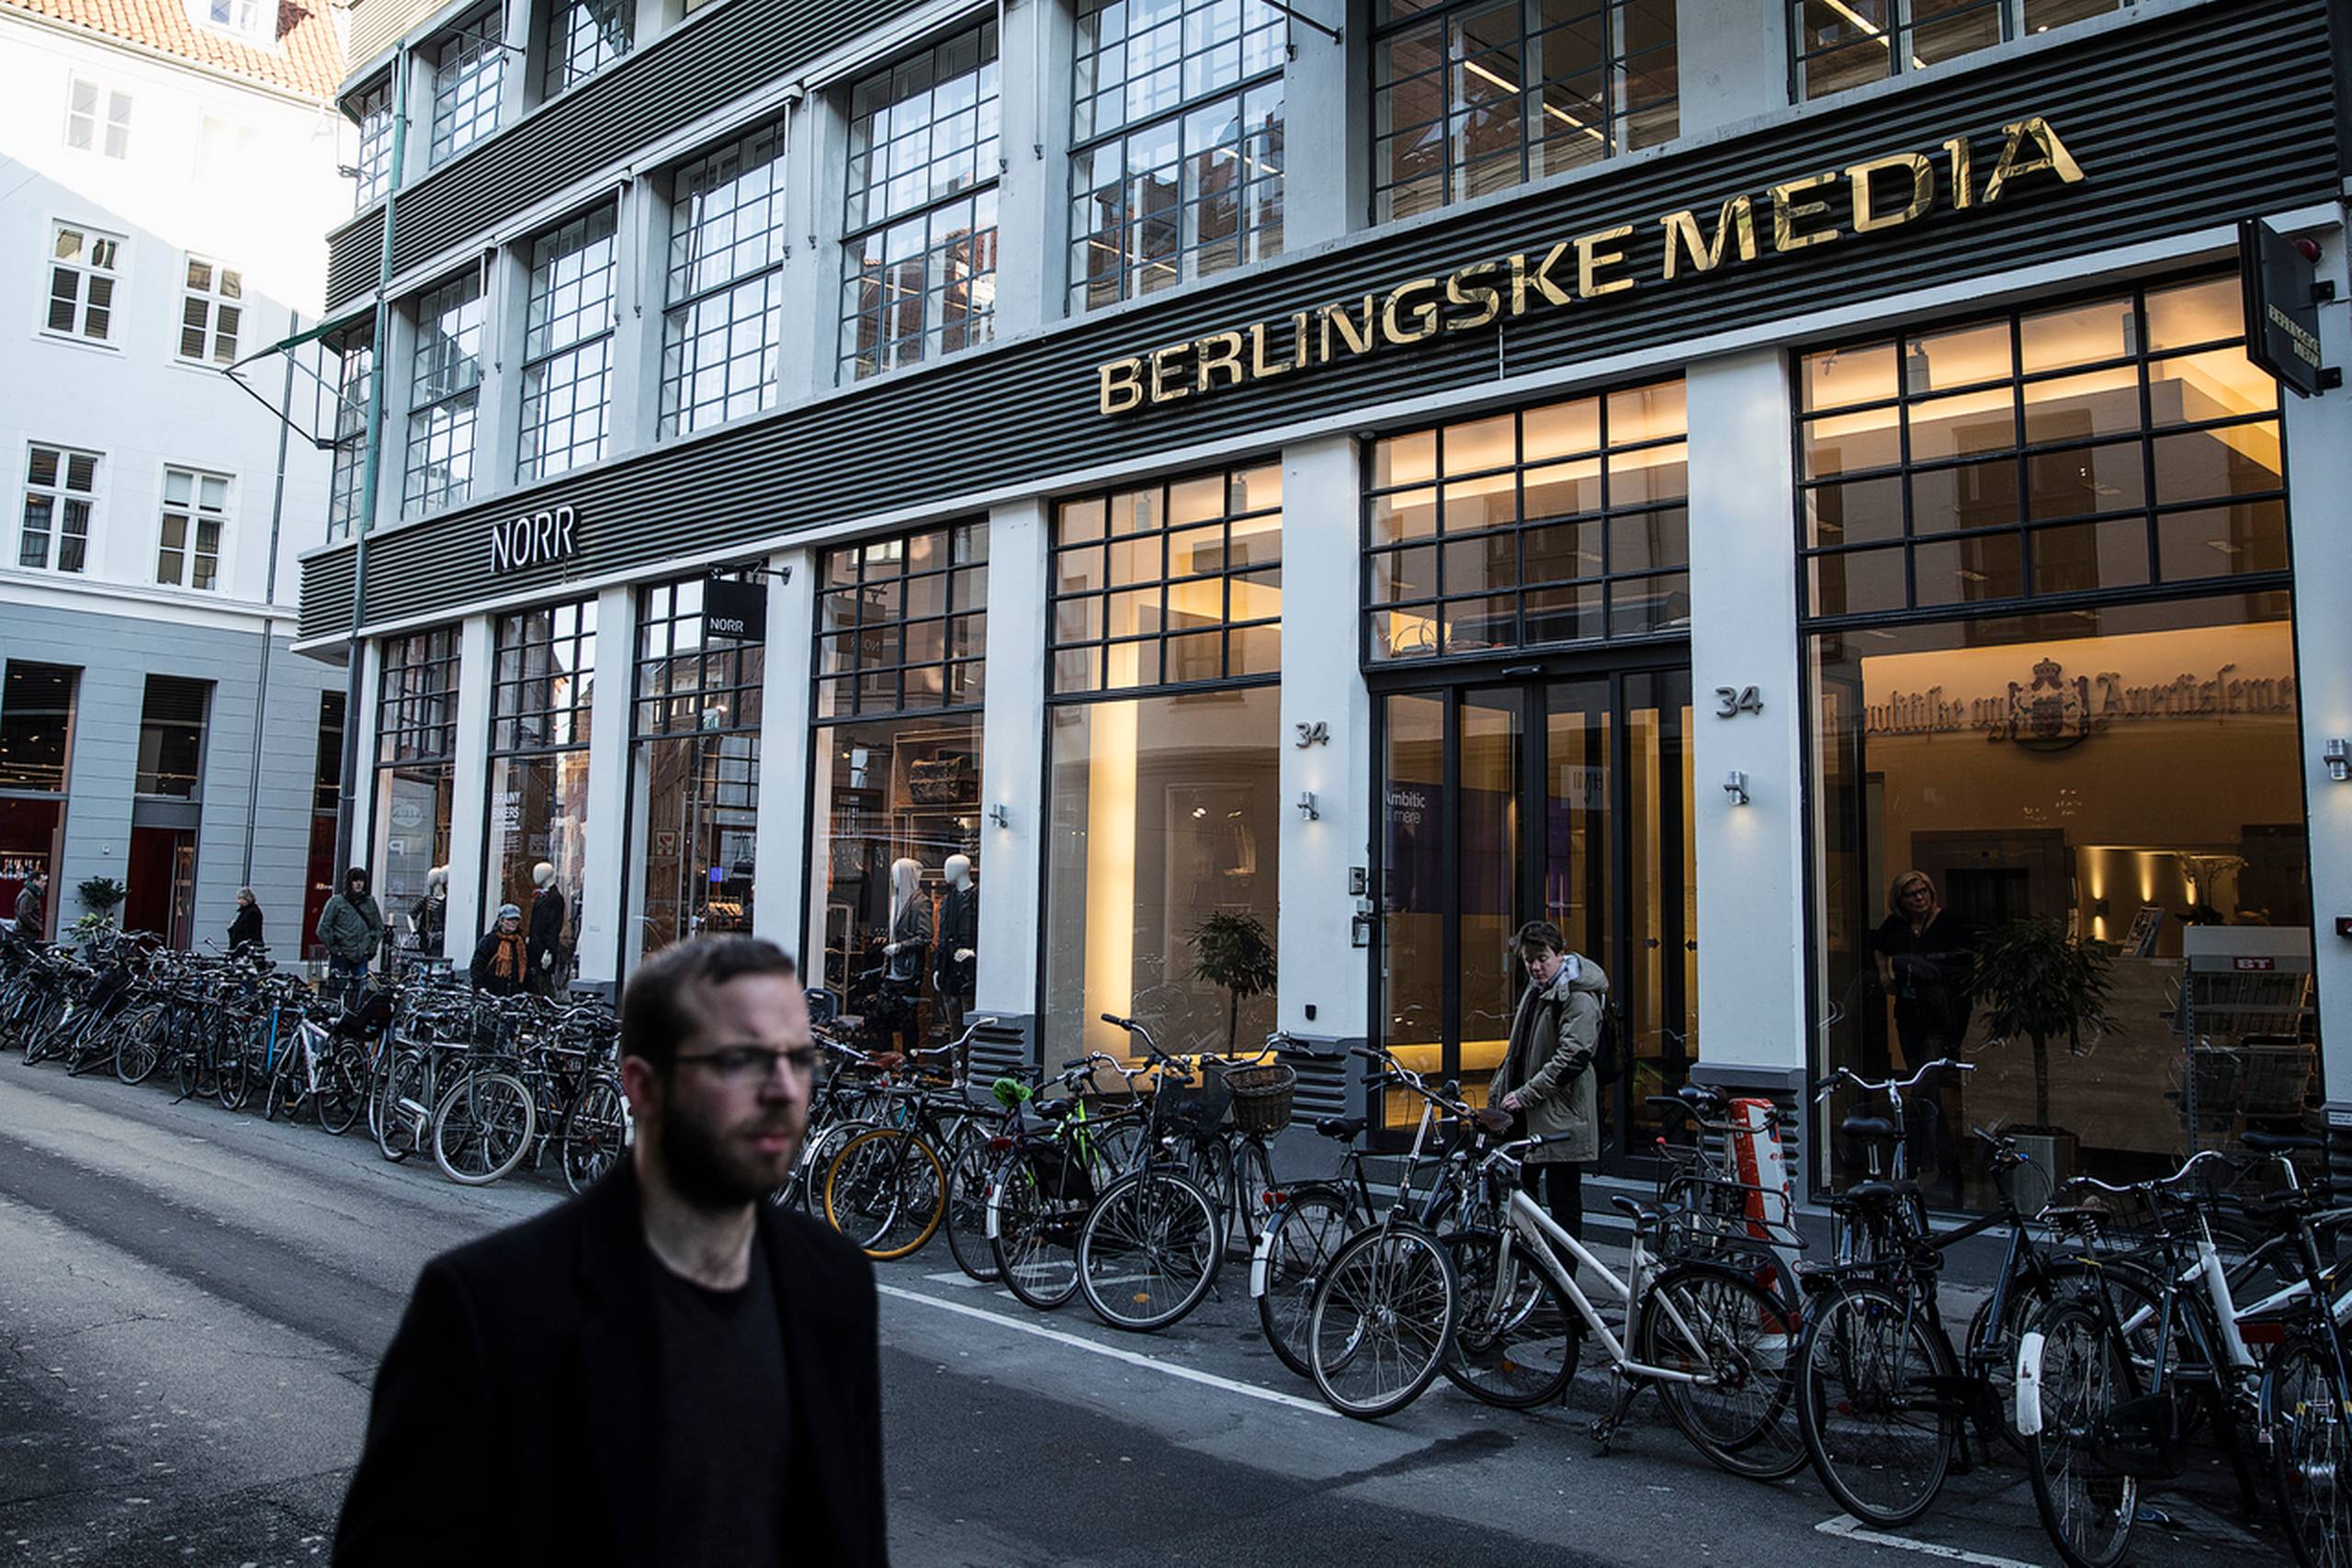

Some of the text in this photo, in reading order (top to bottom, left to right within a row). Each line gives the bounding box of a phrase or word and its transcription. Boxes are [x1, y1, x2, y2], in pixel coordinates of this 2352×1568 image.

[1098, 116, 2086, 415] BERLINGSKE MEDIA
[491, 505, 574, 572] NORR
[709, 617, 743, 633] NORR
[1715, 685, 1764, 718] 34
[1295, 721, 1329, 749] 34
[2237, 958, 2270, 969] BT
